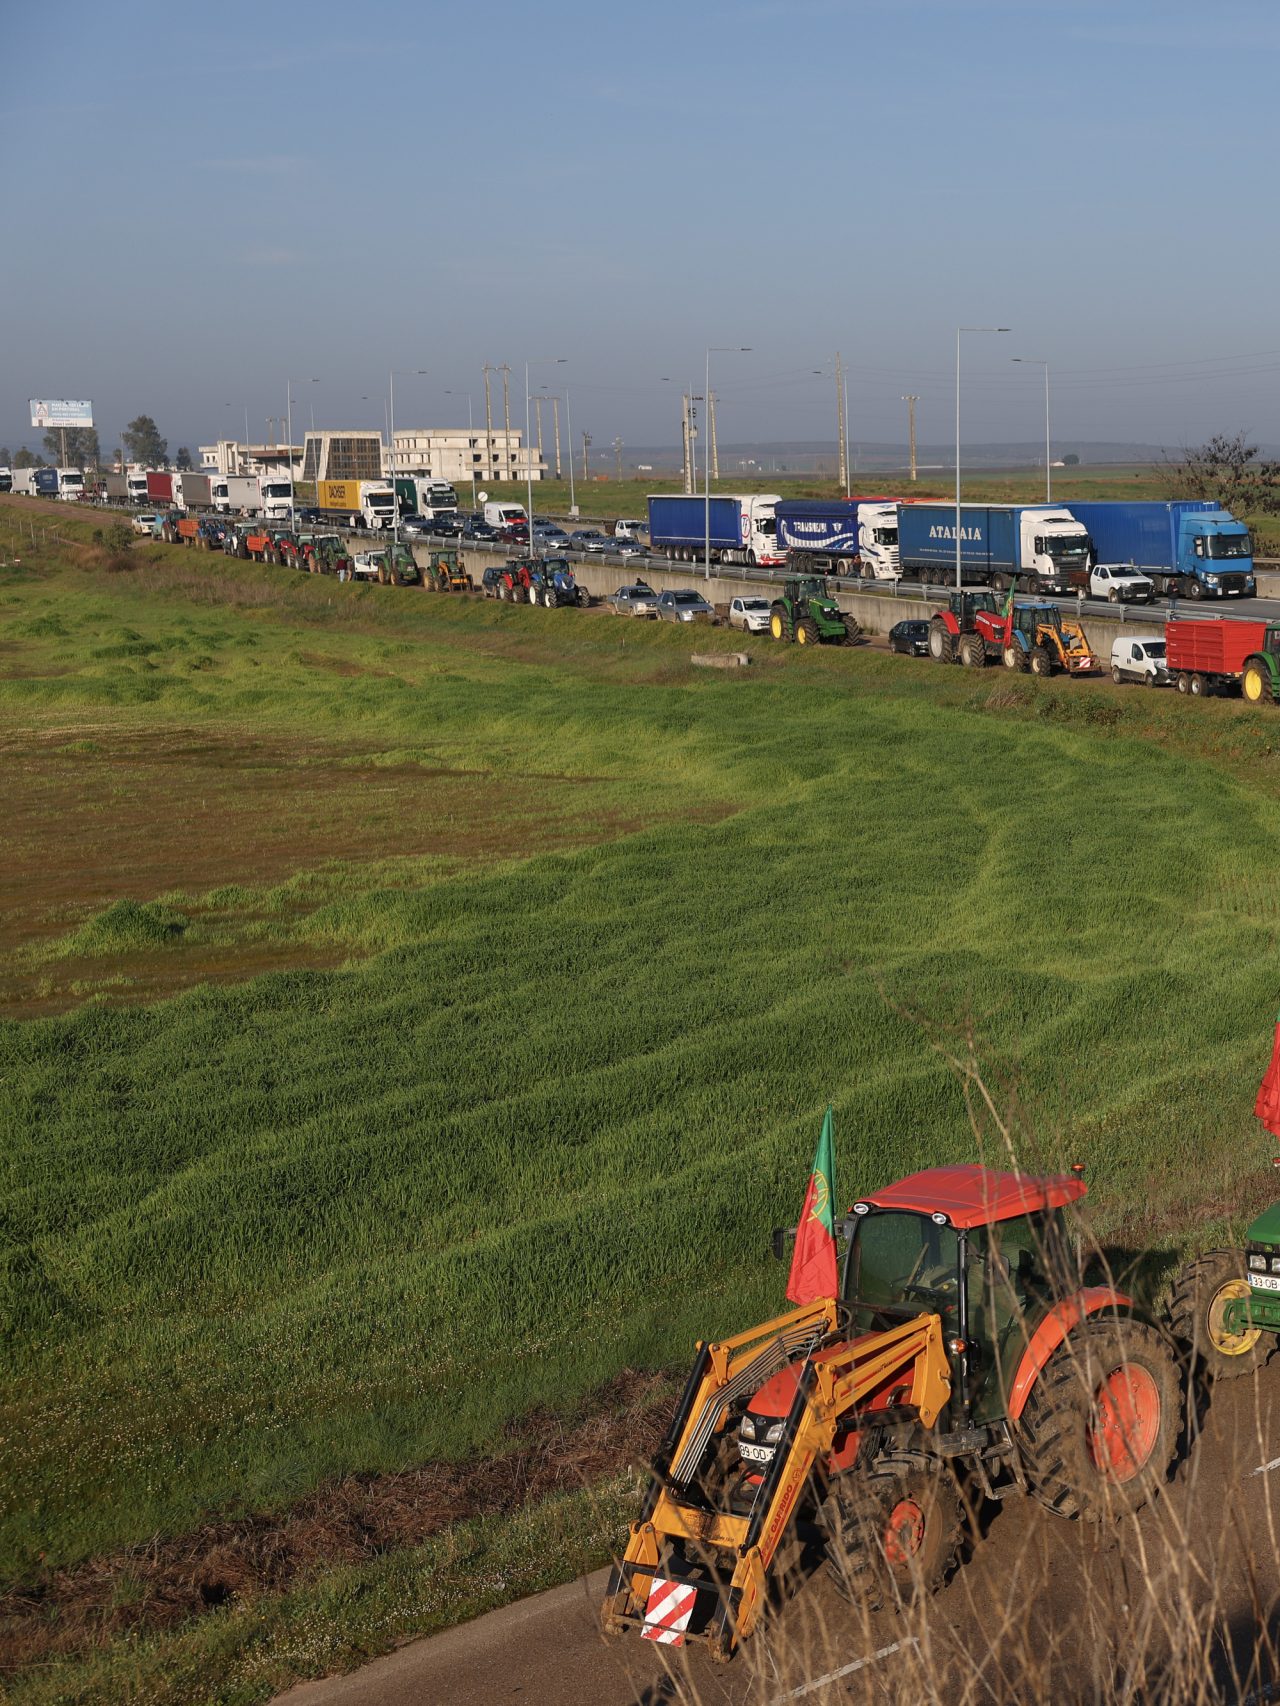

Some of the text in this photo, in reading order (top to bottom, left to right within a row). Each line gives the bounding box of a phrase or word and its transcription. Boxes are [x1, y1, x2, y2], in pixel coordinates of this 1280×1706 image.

[328, 485, 345, 498] DACHSER
[929, 525, 982, 541] ATALAIA
[770, 1483, 793, 1533] GARRIDO
